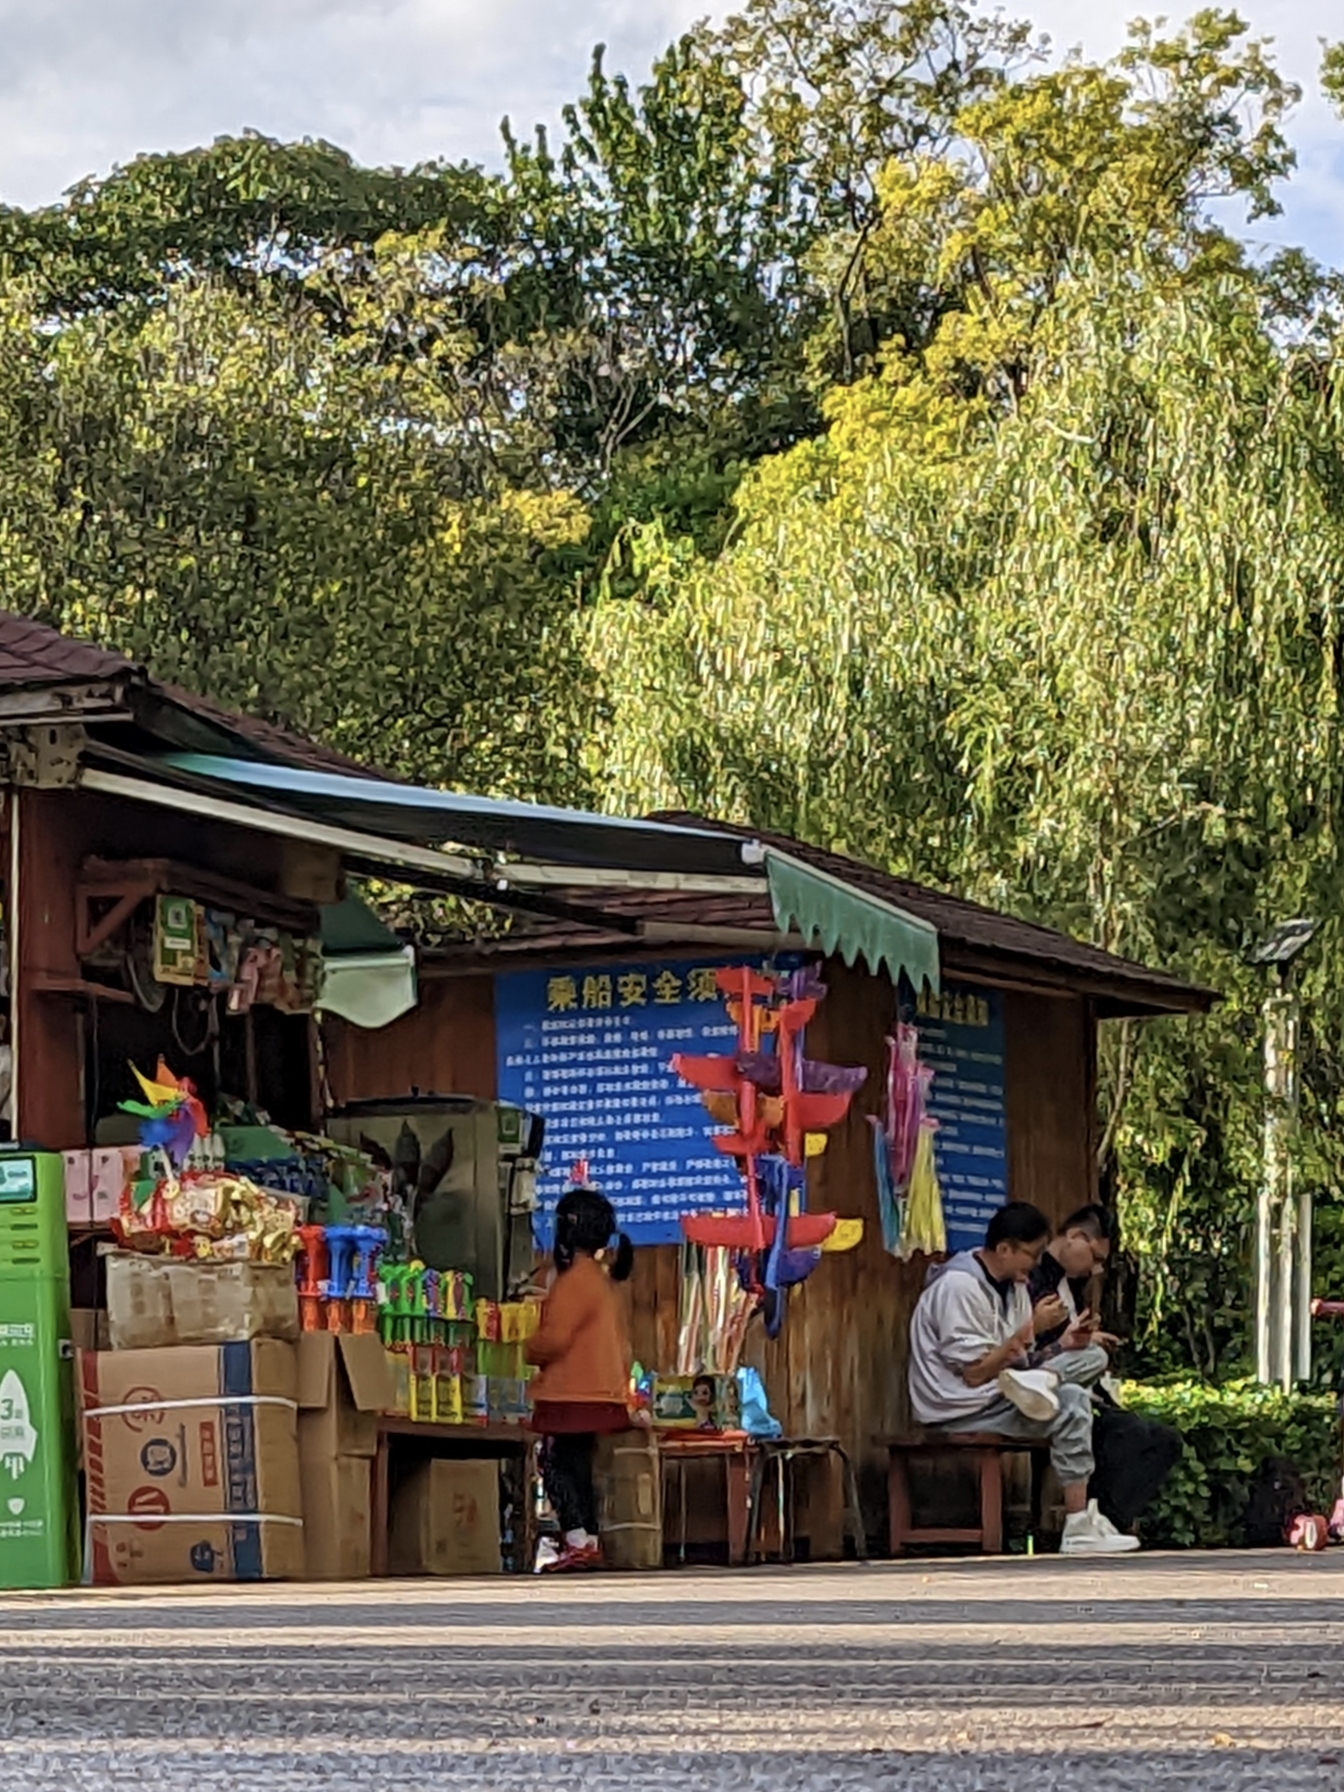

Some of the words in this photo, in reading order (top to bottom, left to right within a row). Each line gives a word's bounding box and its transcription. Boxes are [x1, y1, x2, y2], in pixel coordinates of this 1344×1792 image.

[546, 967, 726, 1013] 乘船安全须
